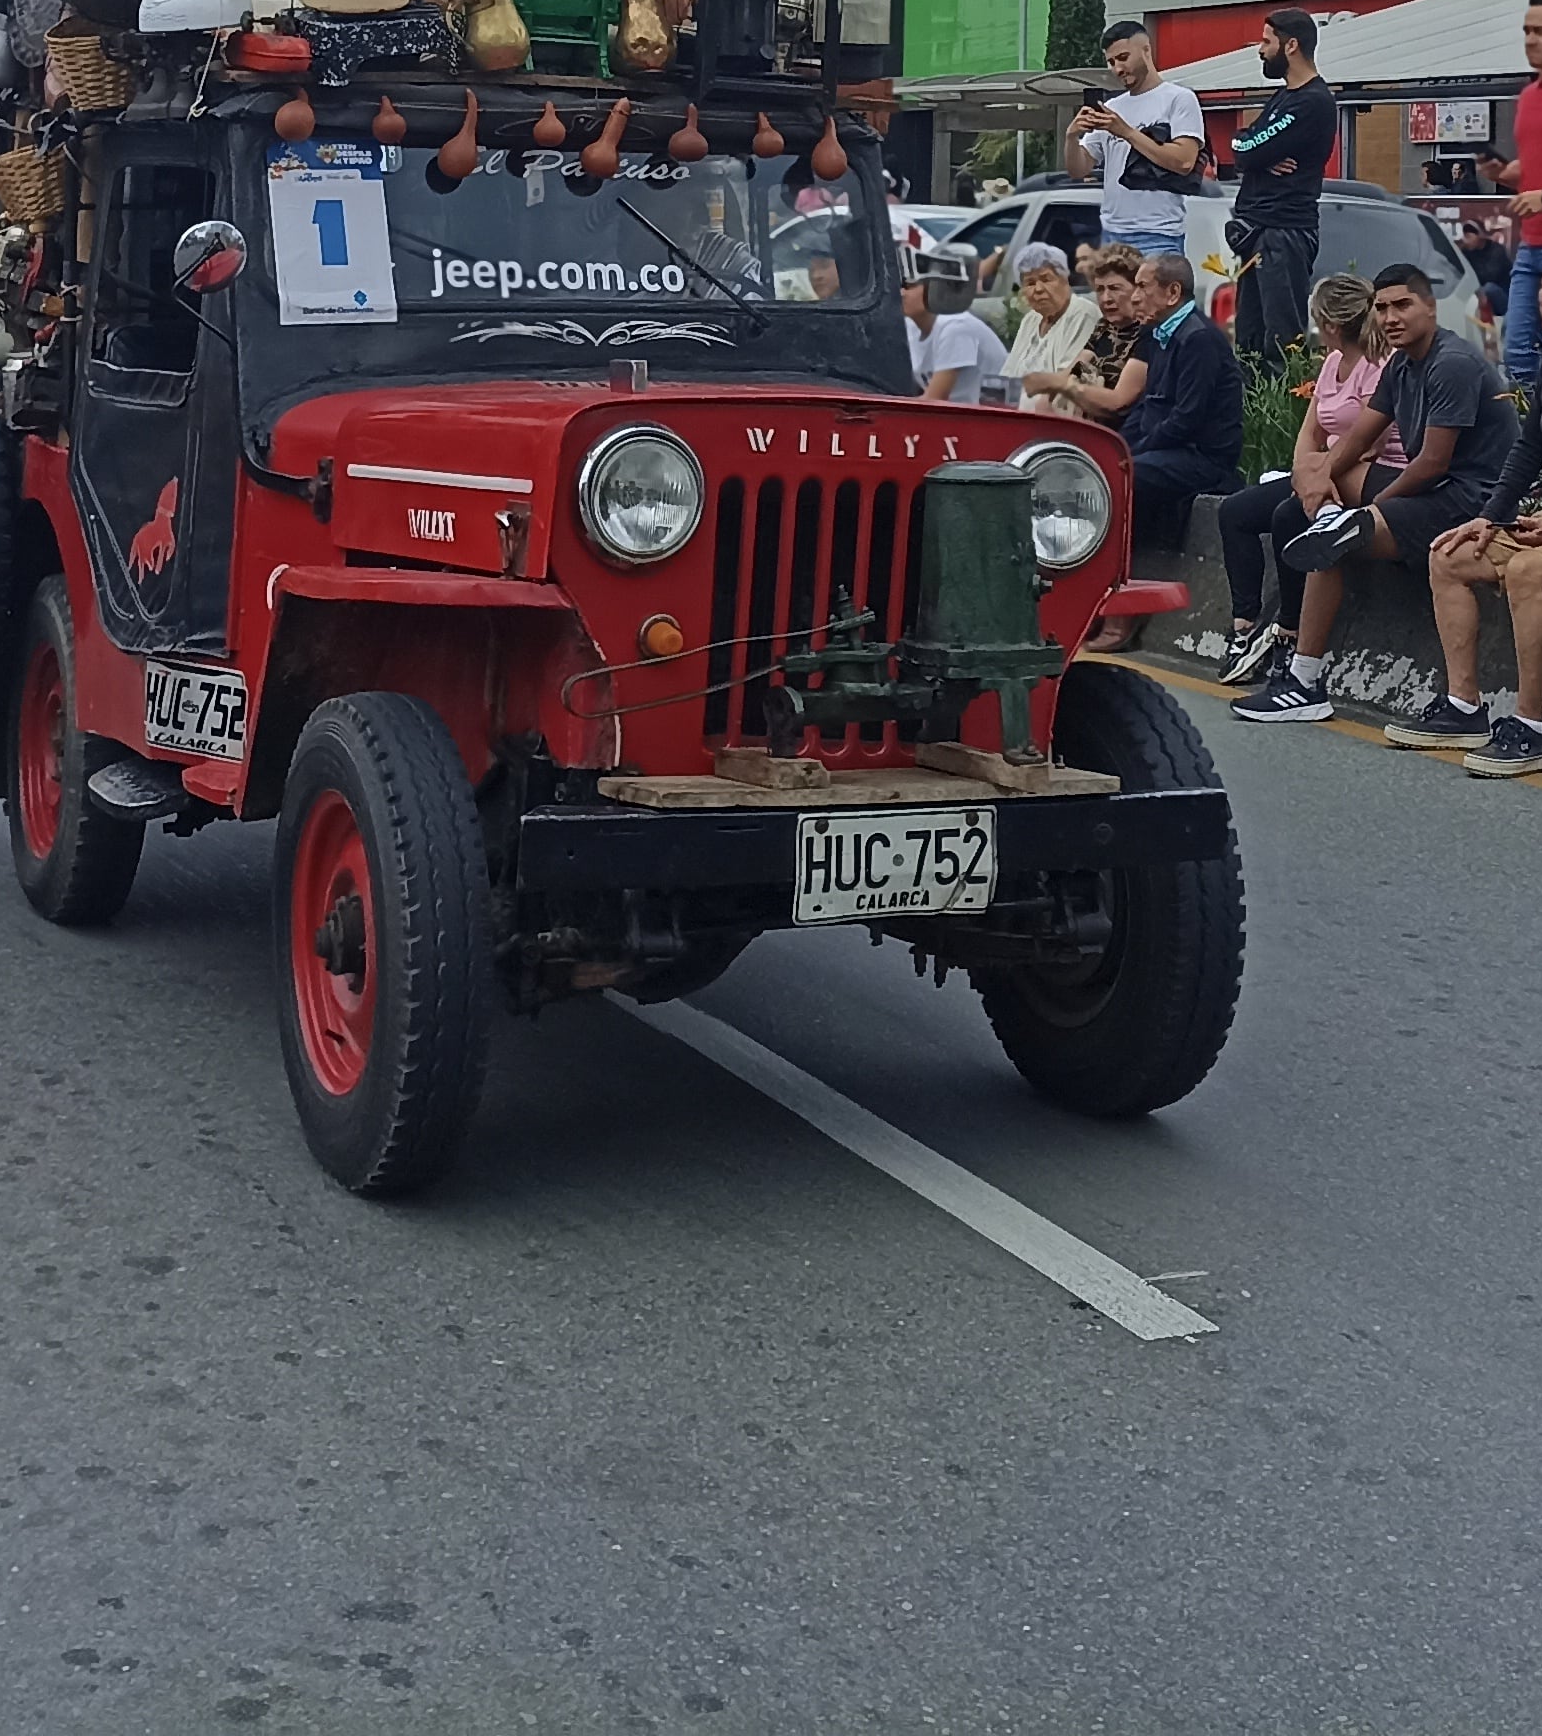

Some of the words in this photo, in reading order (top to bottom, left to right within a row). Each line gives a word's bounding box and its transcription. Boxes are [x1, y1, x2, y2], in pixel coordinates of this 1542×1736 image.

[312, 199, 348, 265] 1
[431, 248, 685, 298] jeep.com.co
[746, 427, 959, 462] WILLYS
[148, 671, 190, 731] HUC
[197, 681, 247, 741] 752
[155, 731, 227, 754] CALARCA
[804, 832, 891, 895] HUC
[905, 827, 988, 887] 752
[856, 889, 930, 911] CALARCA
